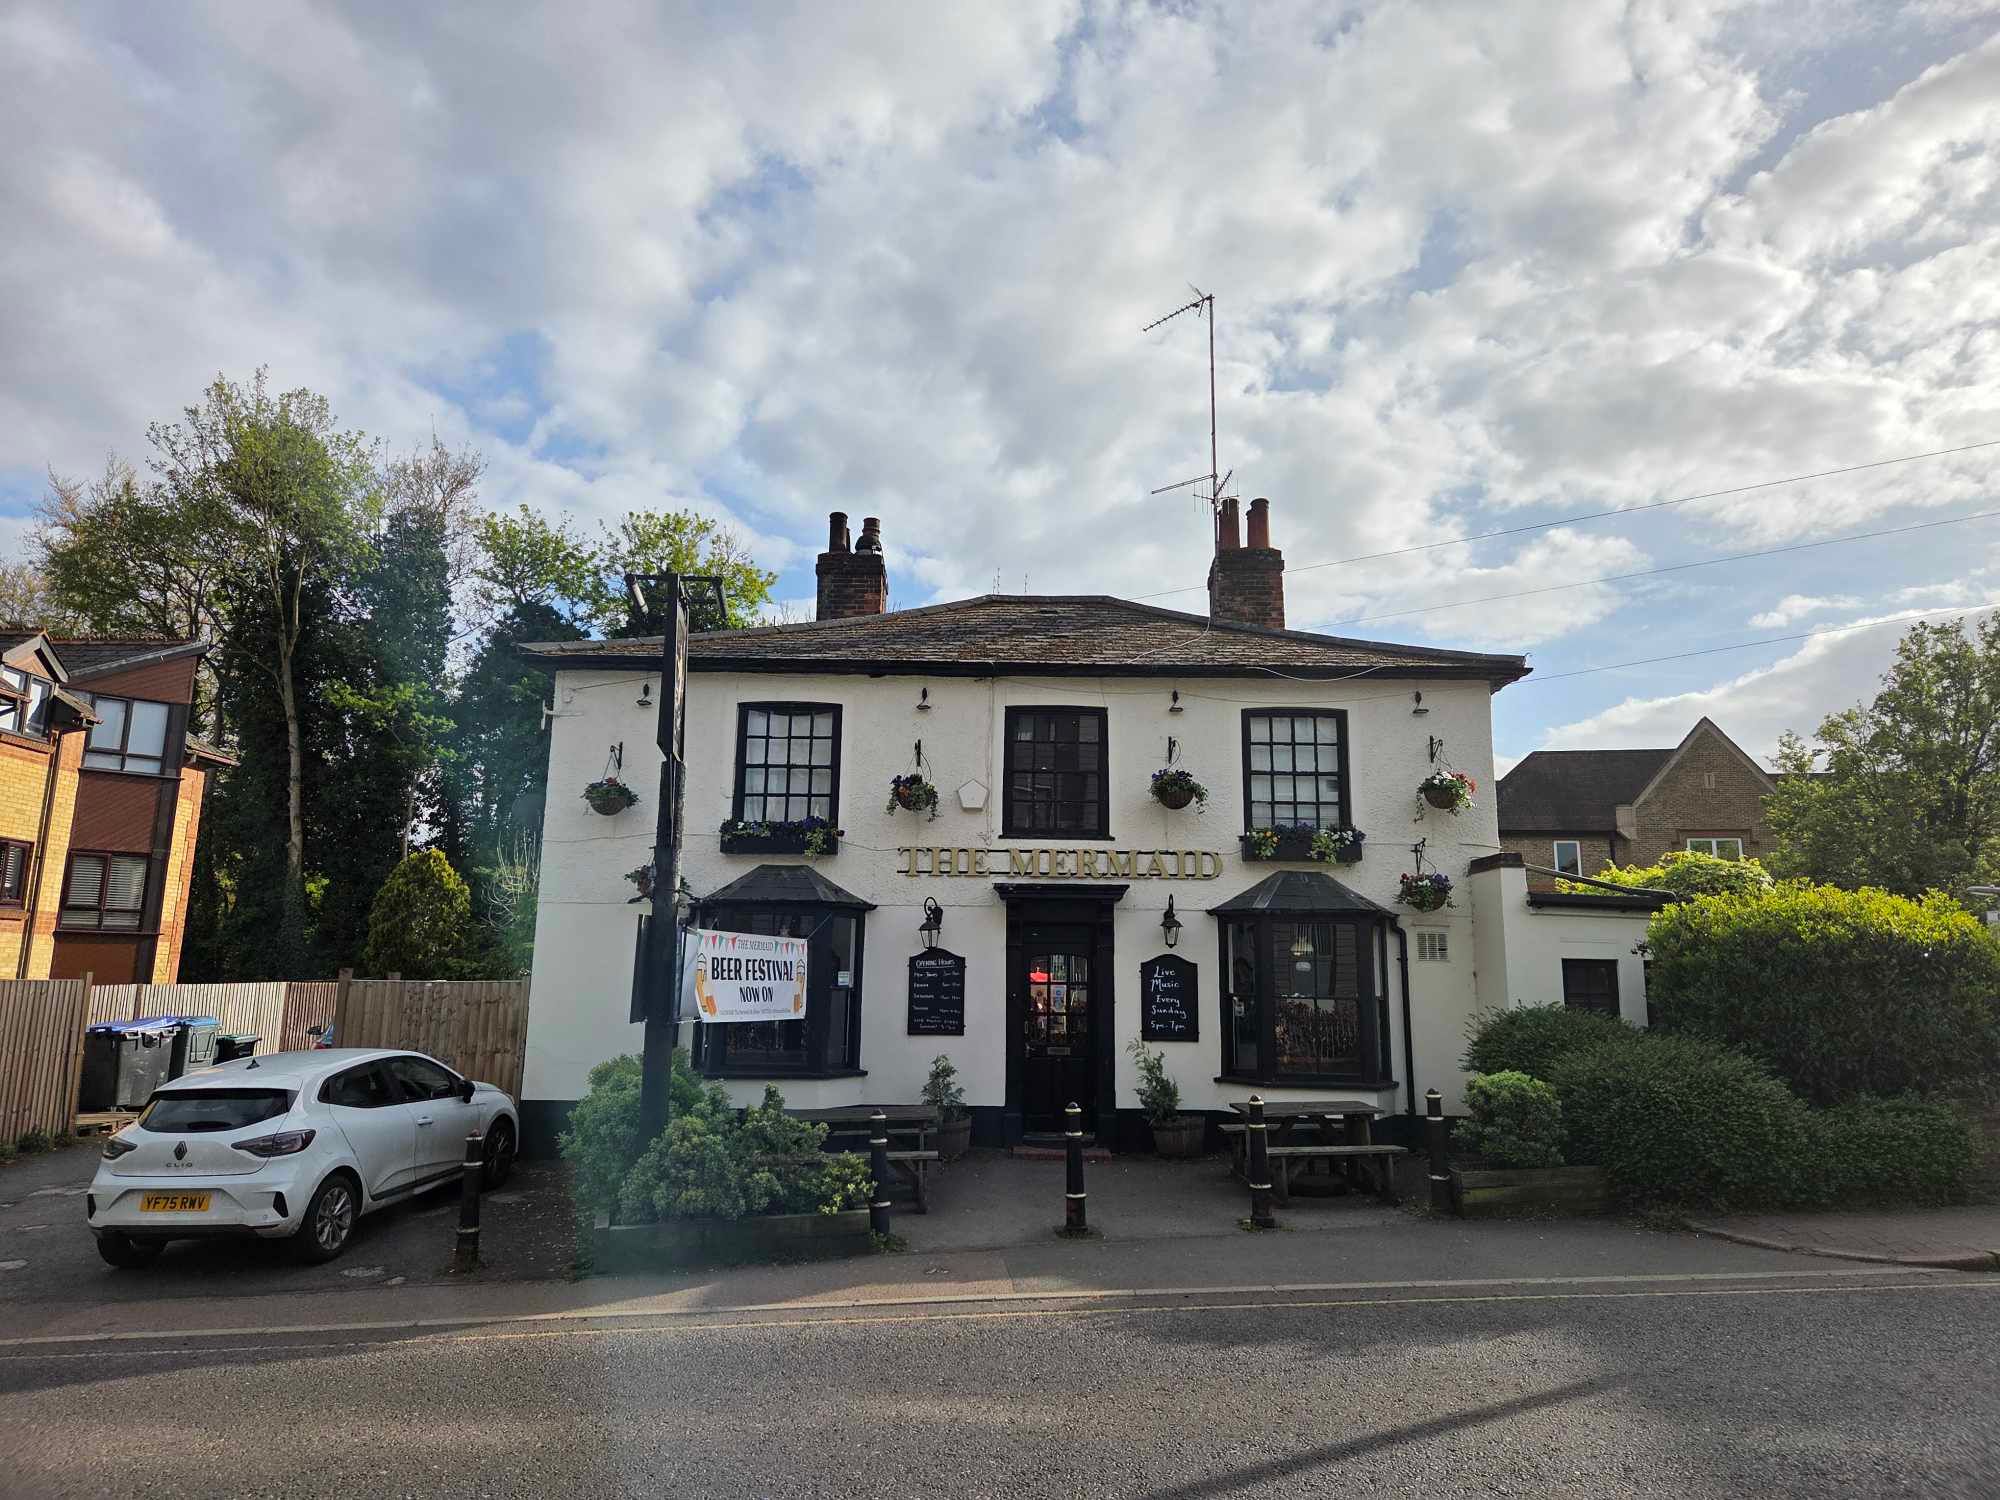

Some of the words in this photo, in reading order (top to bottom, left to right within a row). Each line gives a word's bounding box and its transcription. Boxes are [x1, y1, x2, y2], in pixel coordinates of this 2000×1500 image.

[899, 848, 990, 877] THE
[1009, 849, 1222, 880] MERMAID
[711, 957, 742, 980] BEER
[745, 958, 793, 981] FESTIVAL
[1154, 966, 1176, 977] Live
[1151, 978, 1180, 992] Music
[739, 986, 759, 1003] NOW
[762, 986, 774, 1003] ON
[1156, 995, 1180, 1007] Every
[1152, 1005, 1187, 1019] Sunday
[146, 1197, 178, 1209] YF75
